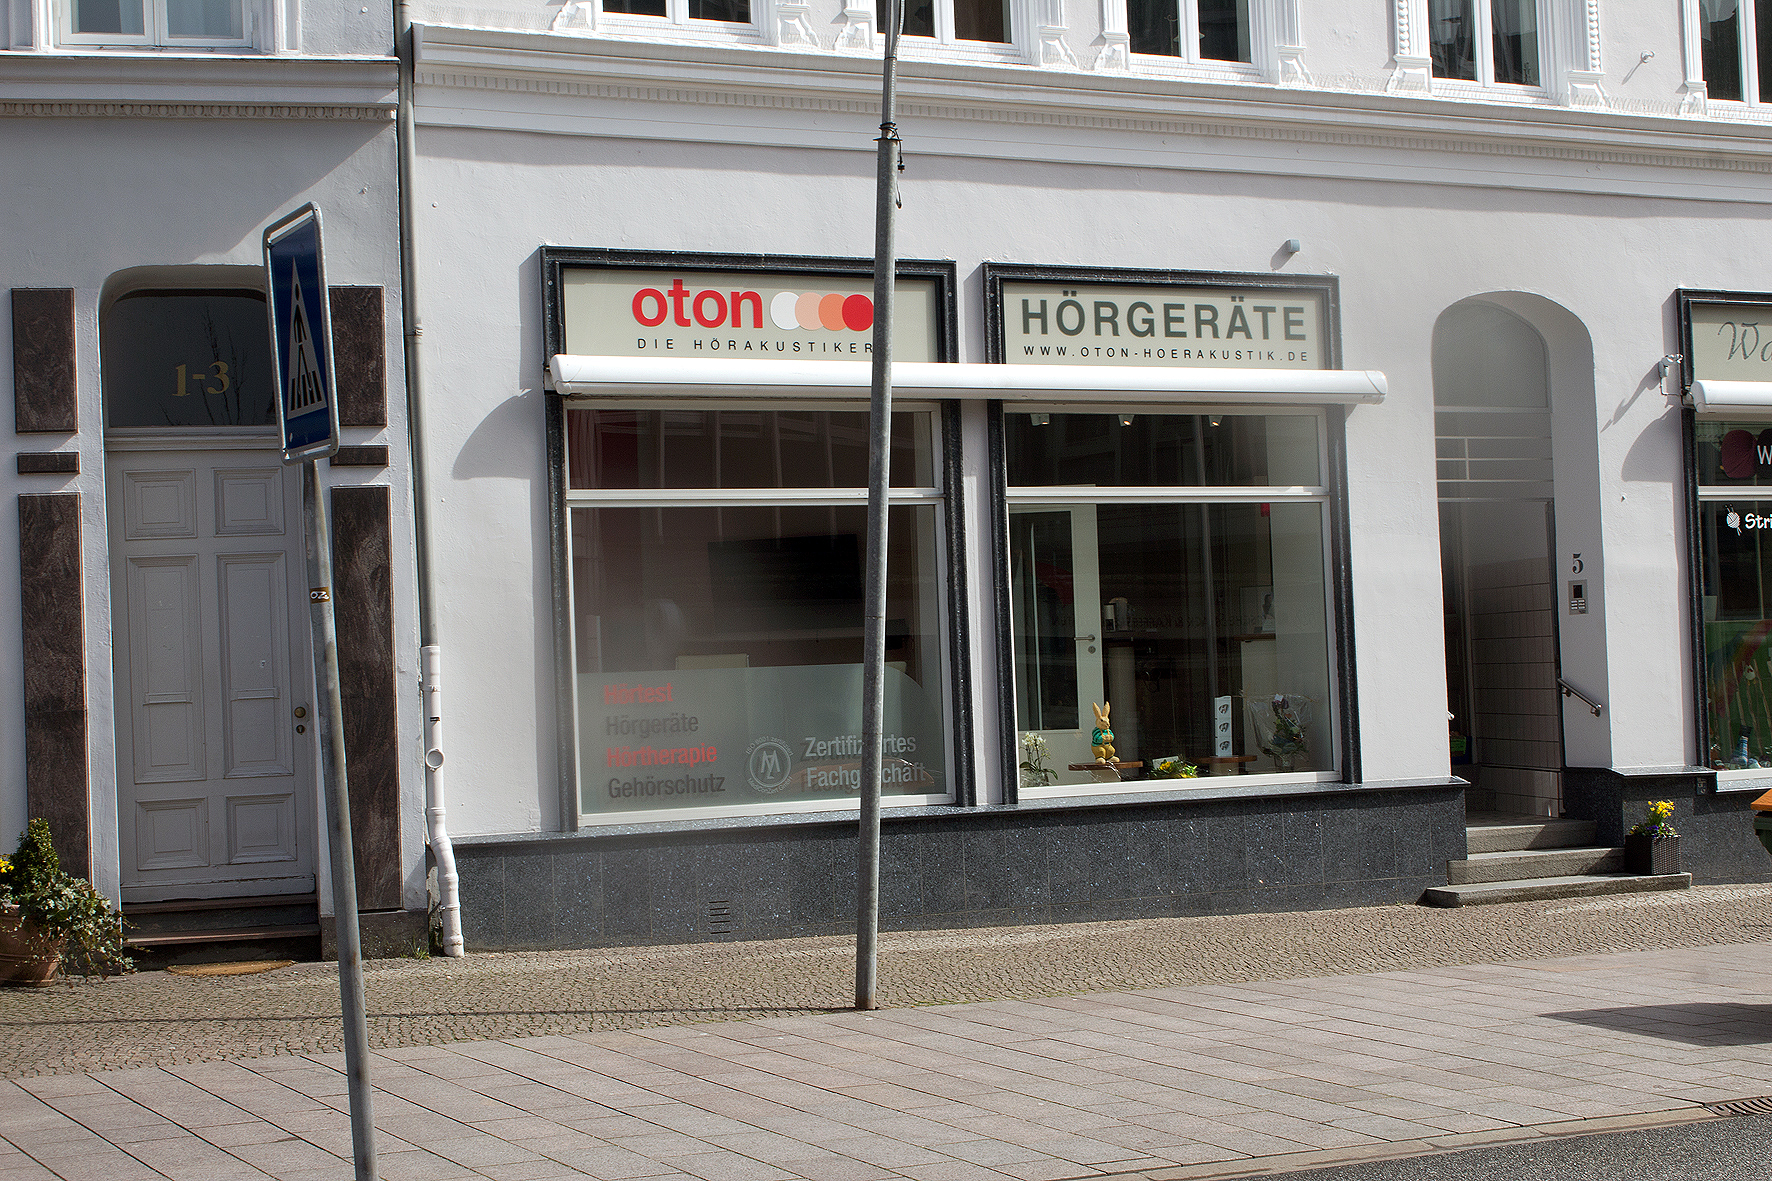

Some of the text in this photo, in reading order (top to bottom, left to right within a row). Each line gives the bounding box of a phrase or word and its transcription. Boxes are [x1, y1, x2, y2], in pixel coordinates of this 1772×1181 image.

[631, 279, 763, 329] oton
[1021, 290, 1306, 341] HÖRGERÄTE
[638, 337, 873, 354] DIE HÖRAKUSTIKER
[1024, 345, 1308, 362] WWW.OTON-HOERAKUSTIK.DE
[172, 360, 230, 397] 1-3
[1572, 552, 1584, 575] 5
[604, 682, 674, 705] Hörtest
[605, 712, 699, 739] Hörgeräte
[606, 742, 718, 768] Hörtherapie
[608, 773, 726, 799] Gehörschutz
[806, 762, 926, 790] Fachgchäft
